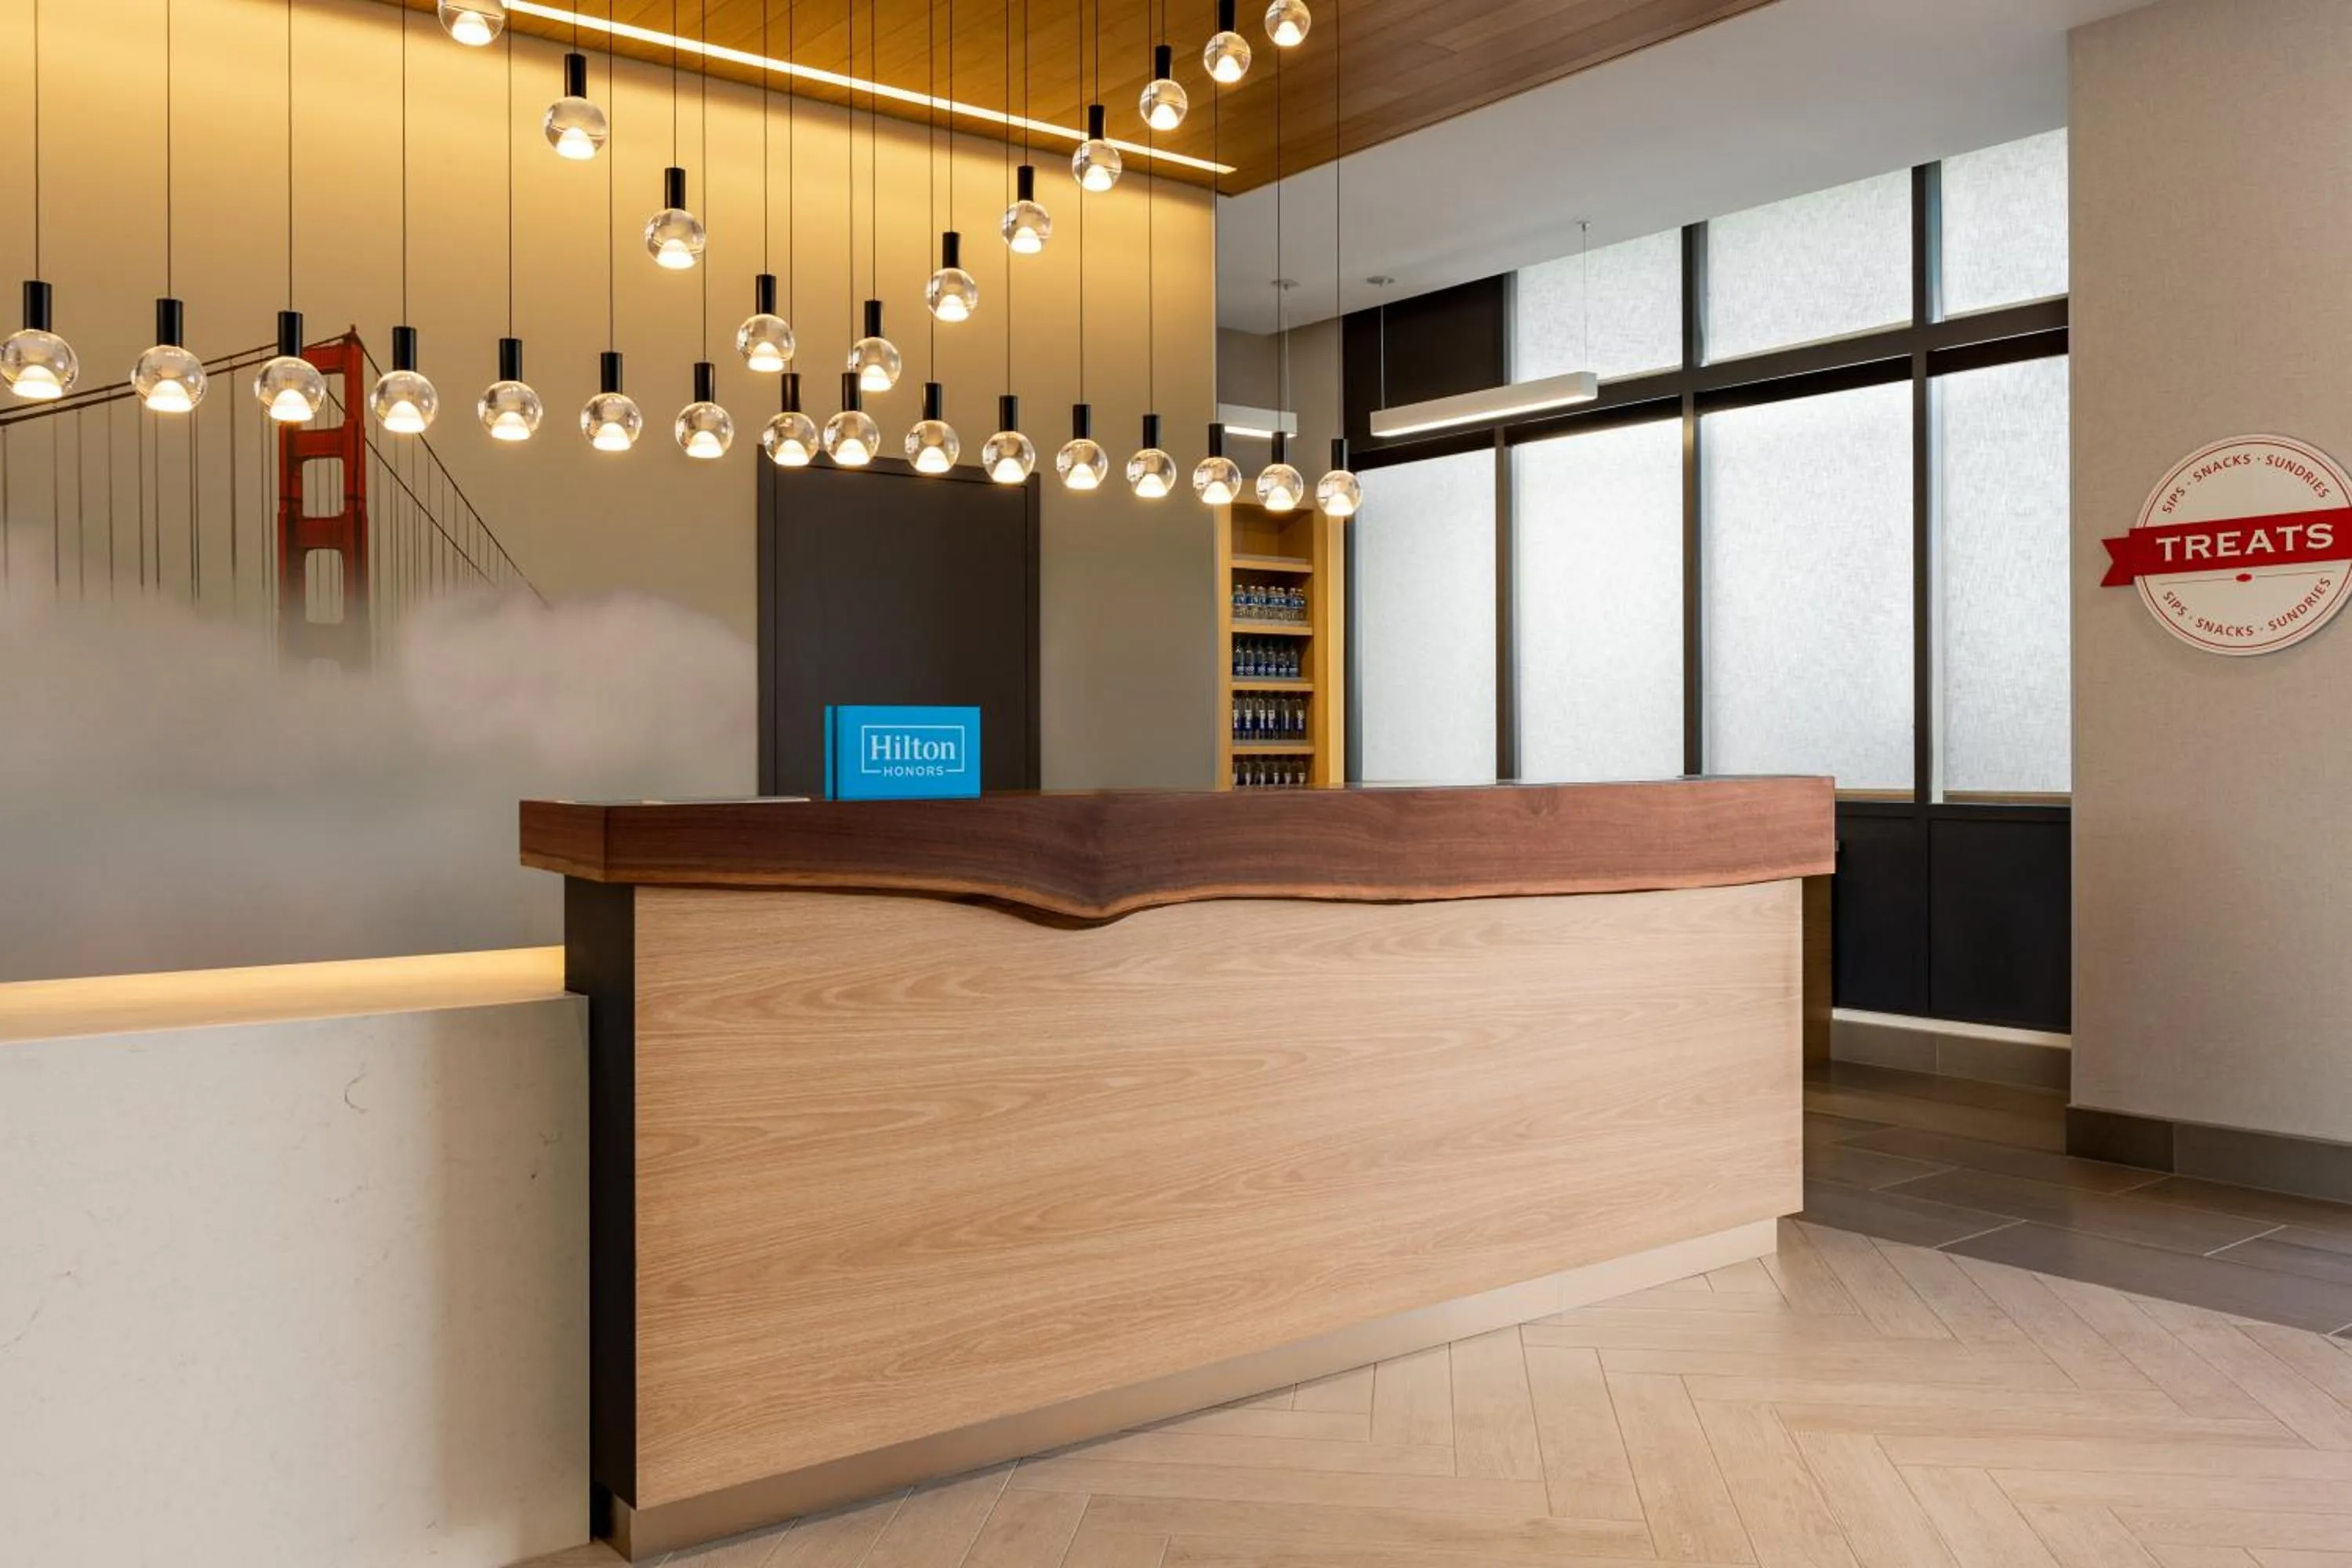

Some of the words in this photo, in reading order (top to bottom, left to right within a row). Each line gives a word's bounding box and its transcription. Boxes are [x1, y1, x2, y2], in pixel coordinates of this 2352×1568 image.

[2161, 487, 2186, 514] SIPS
[2193, 454, 2252, 482] SNACKS
[2265, 454, 2330, 499] SUNDRIES
[2156, 523, 2334, 561] TREATS
[2162, 590, 2187, 616] SIPS
[2195, 618, 2254, 637] SNACKS
[2267, 577, 2332, 631] SUNDRIES
[870, 735, 956, 760] Hilton
[884, 766, 944, 777] HONORS
